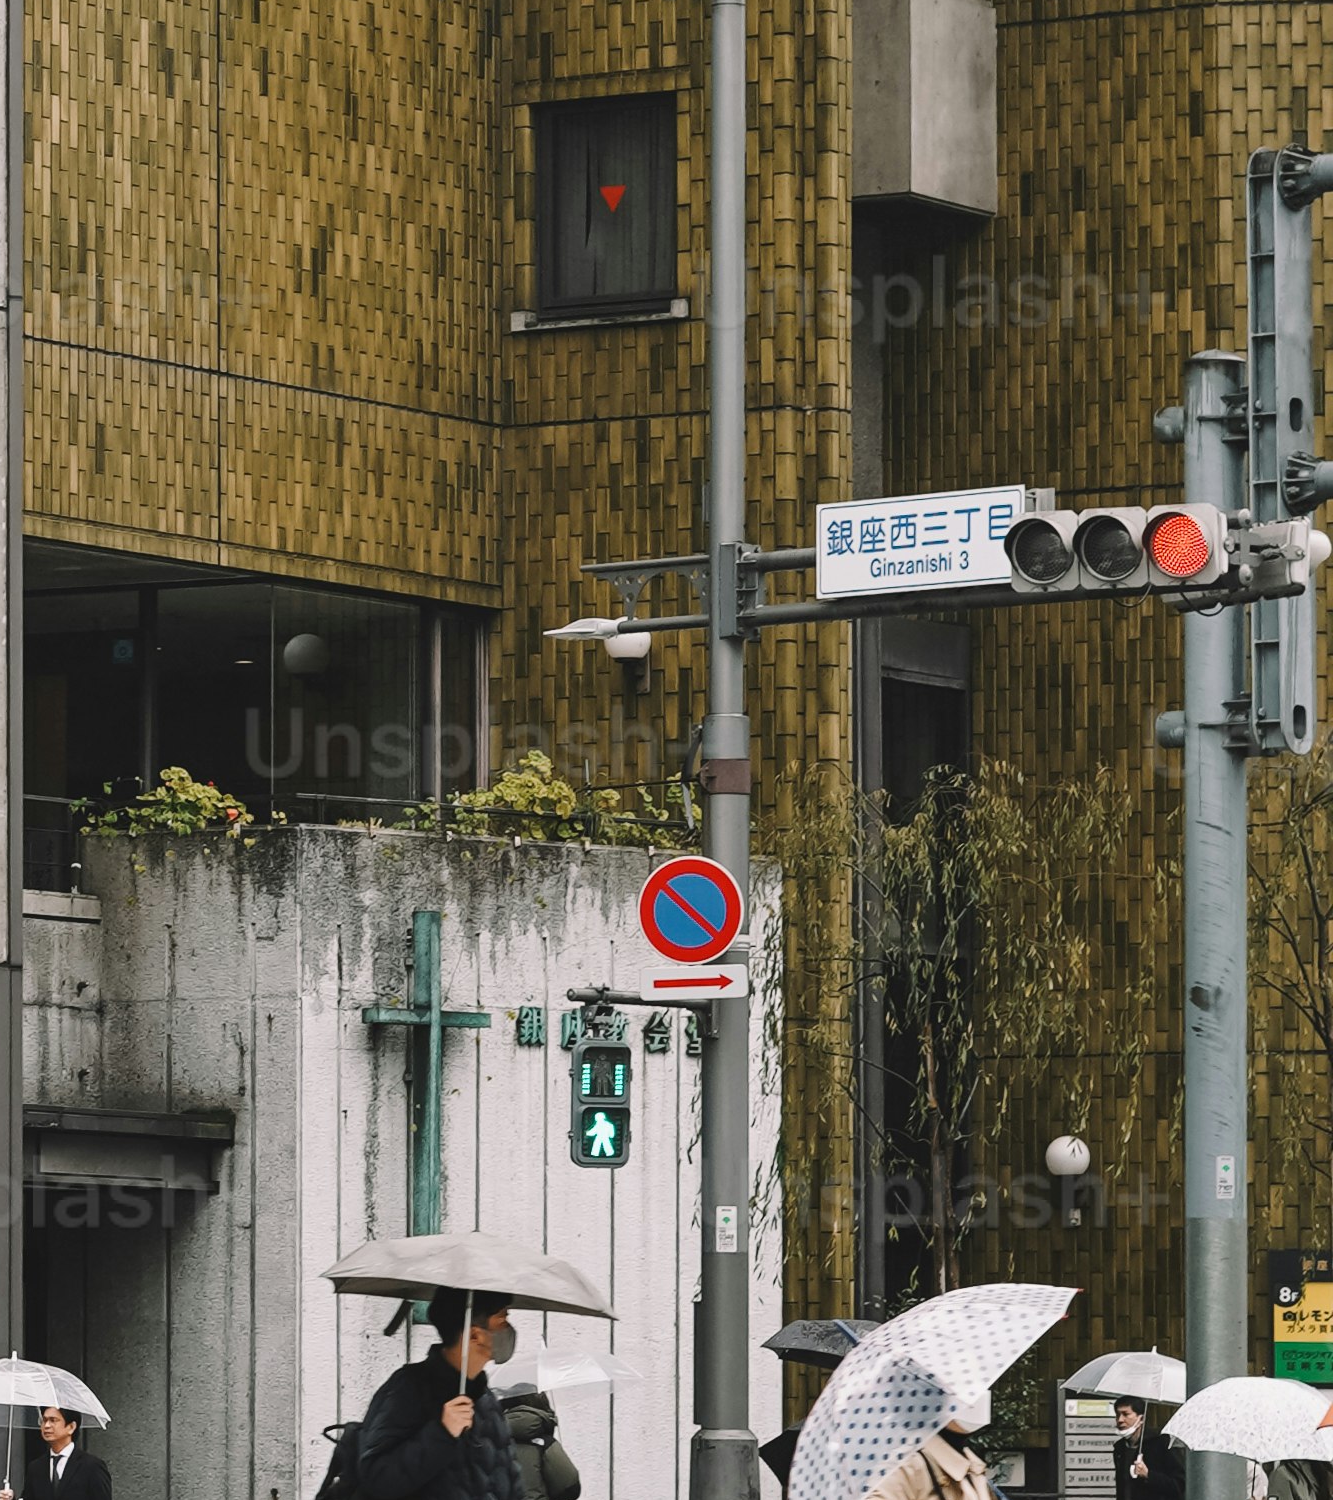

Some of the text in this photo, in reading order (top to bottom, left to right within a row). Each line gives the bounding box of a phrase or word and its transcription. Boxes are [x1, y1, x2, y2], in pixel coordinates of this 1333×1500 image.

[826, 503, 1014, 556] 銀座西三丁目
[870, 550, 970, 578] Ginzanishi 3
[1278, 1286, 1299, 1303] 8F
